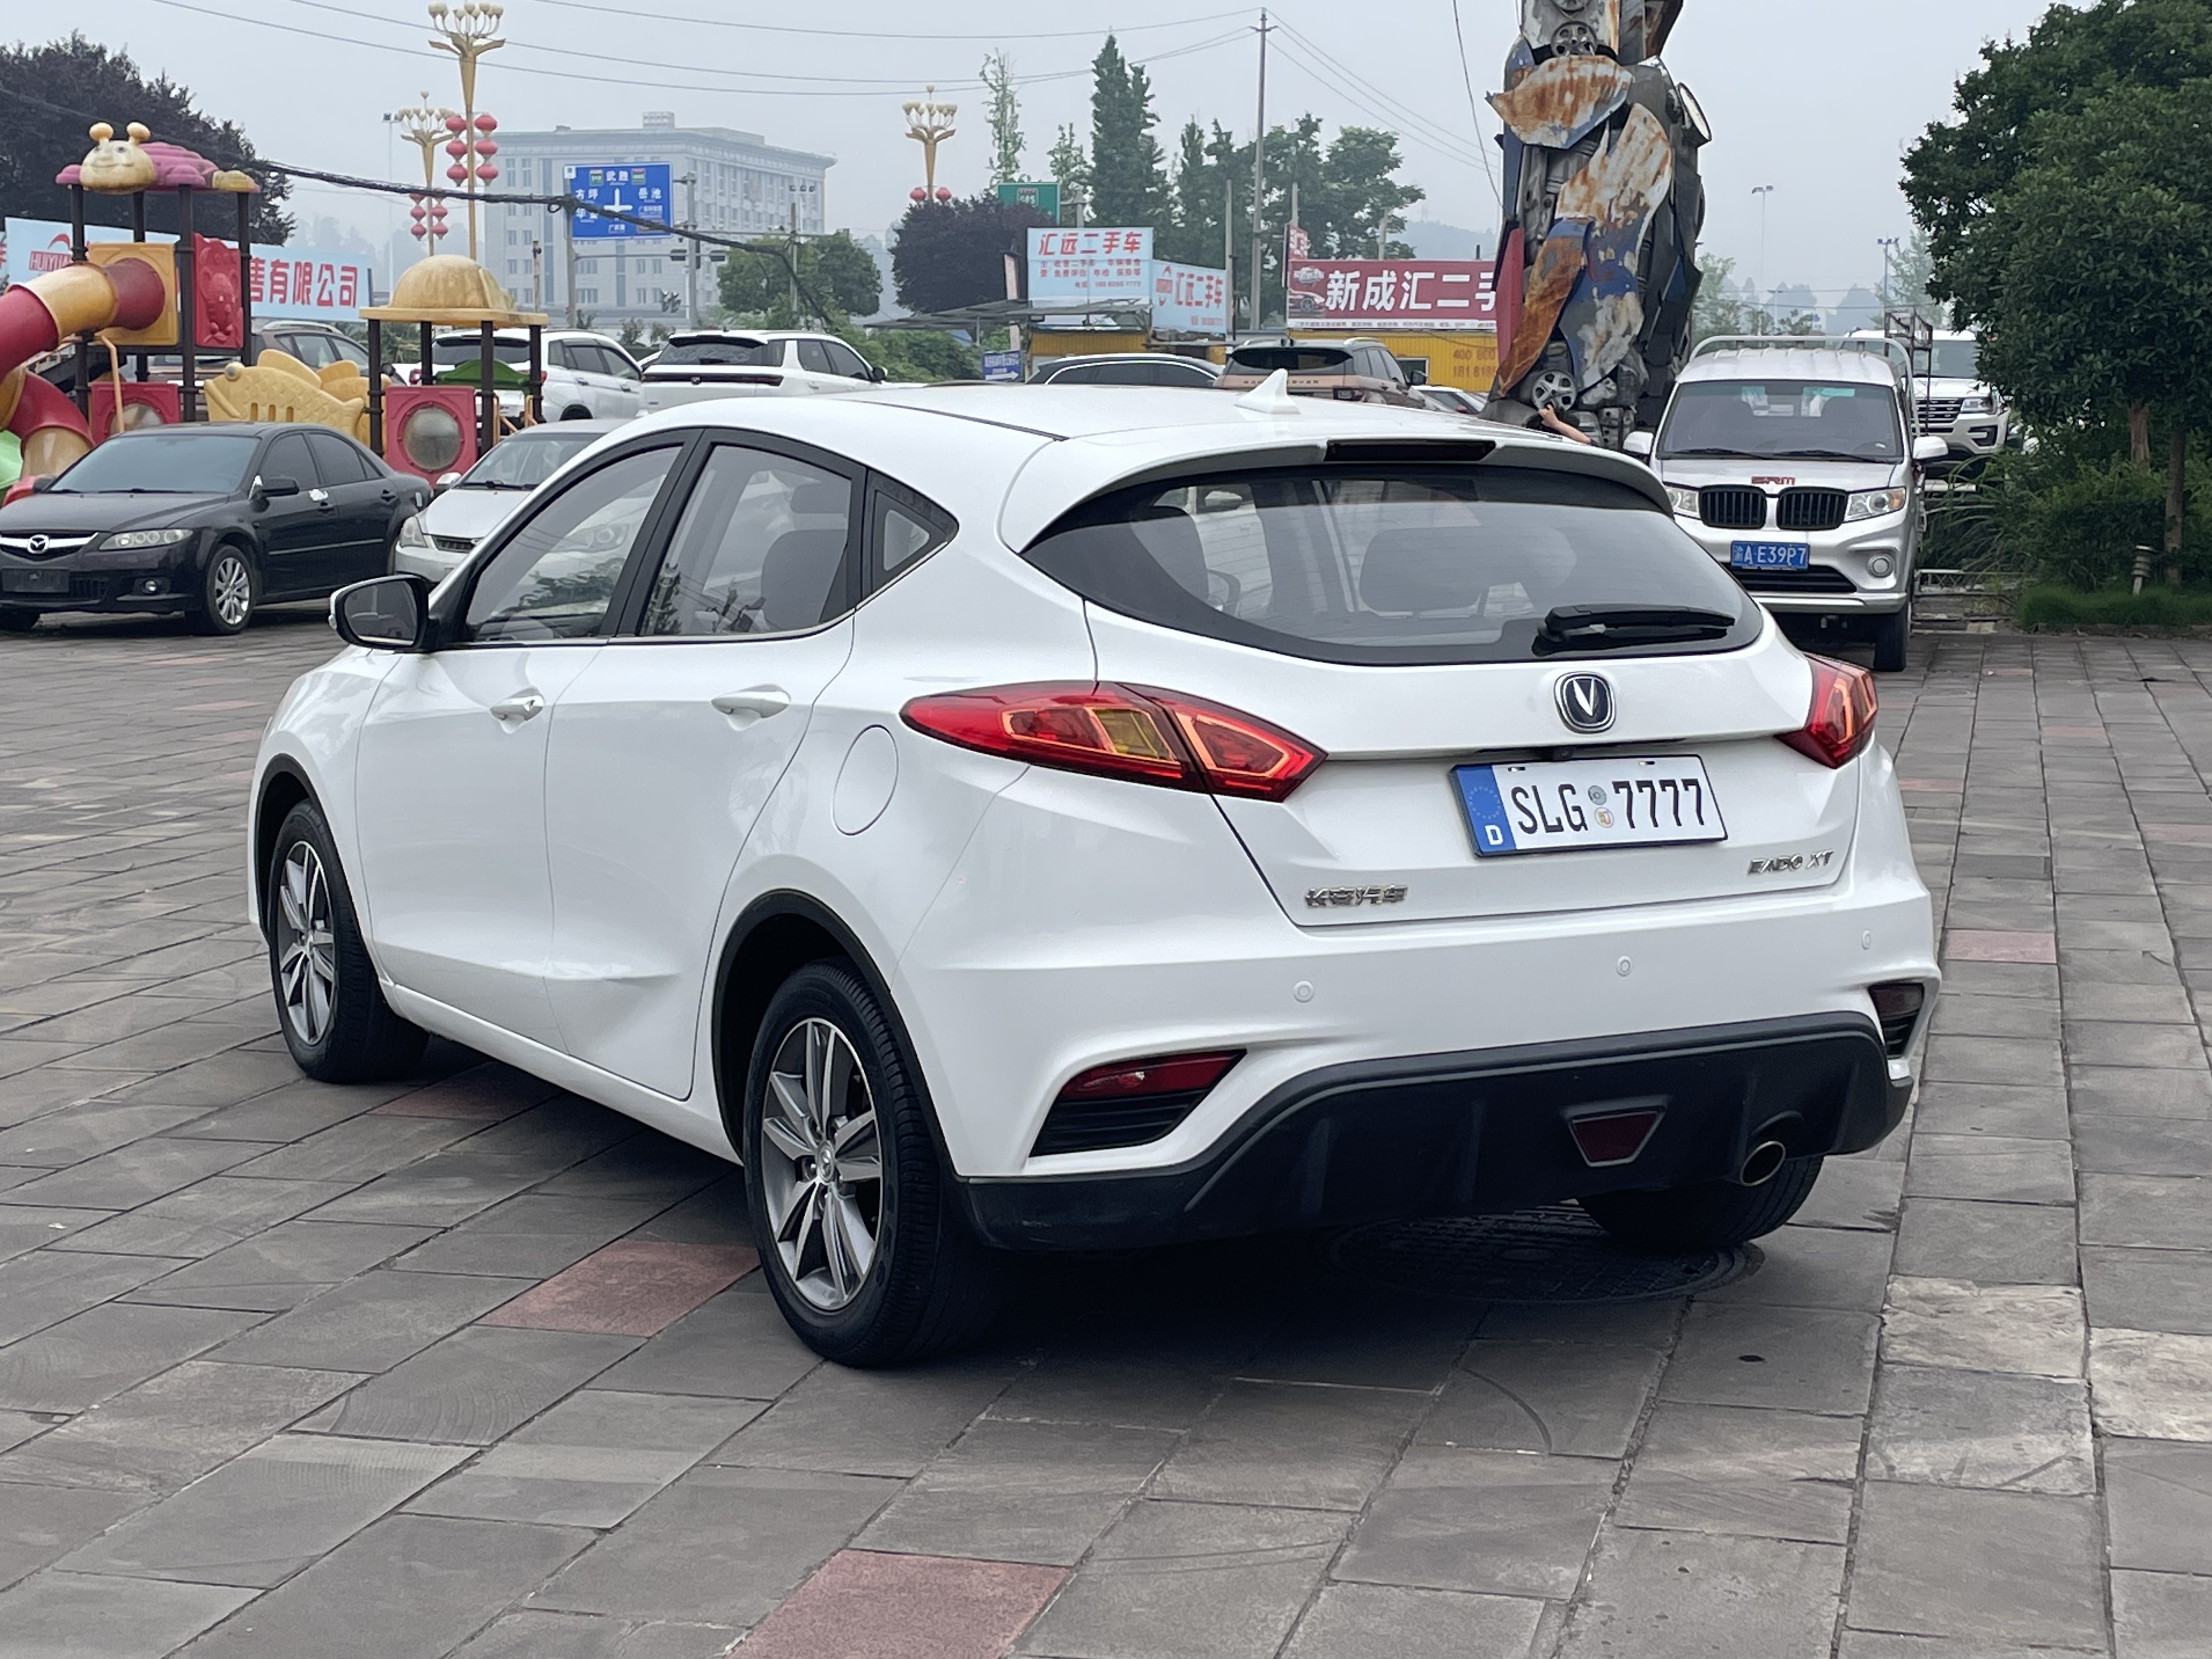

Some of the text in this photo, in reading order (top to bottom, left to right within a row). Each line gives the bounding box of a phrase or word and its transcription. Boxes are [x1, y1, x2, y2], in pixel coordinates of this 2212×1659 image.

[1039, 231, 1143, 256] 汇远二手车
[1511, 778, 1705, 834] SLG 7777
[1485, 824, 1504, 845] D
[1747, 849, 1834, 875] EADO XT
